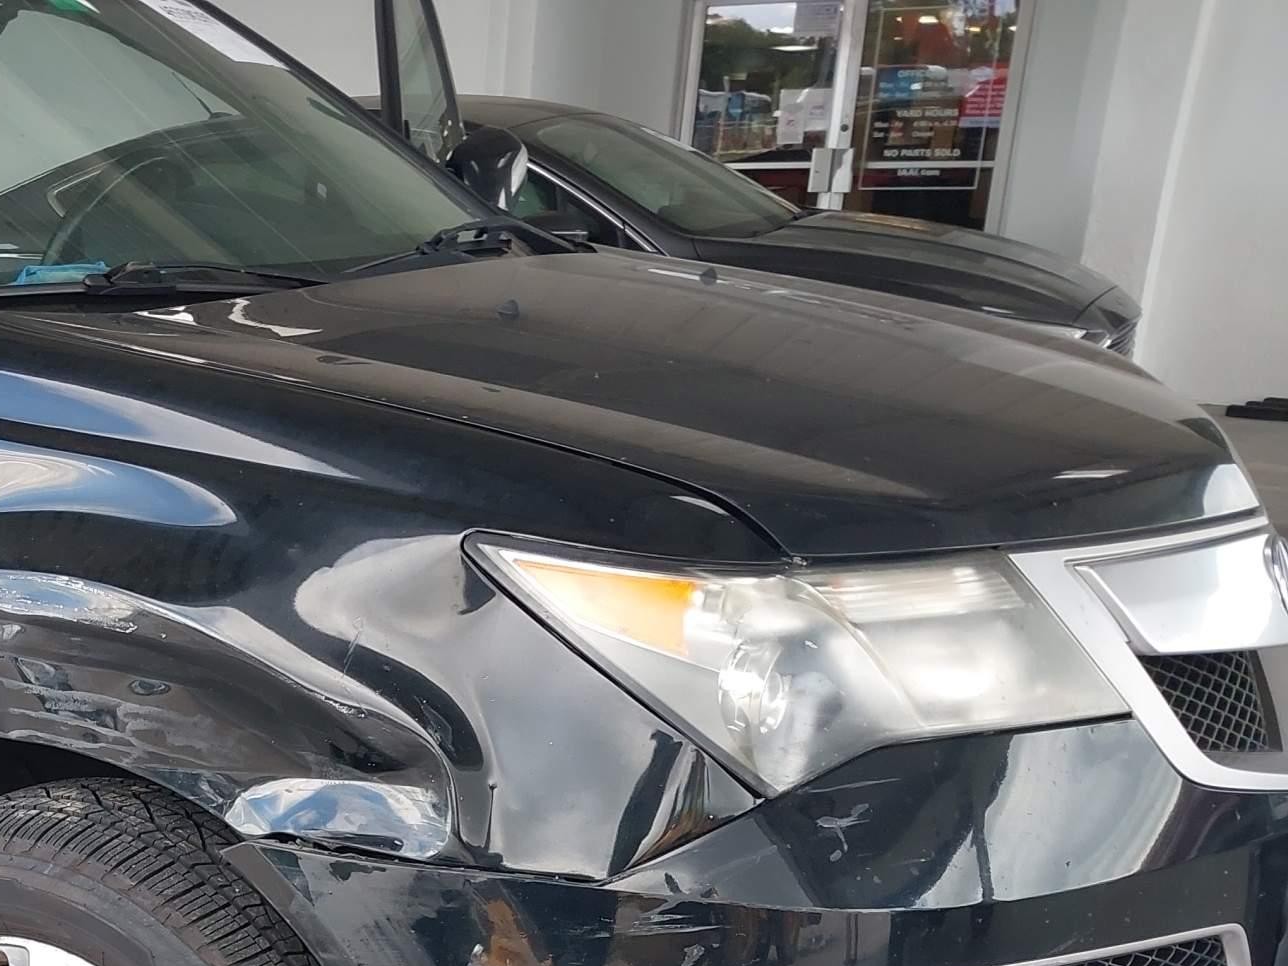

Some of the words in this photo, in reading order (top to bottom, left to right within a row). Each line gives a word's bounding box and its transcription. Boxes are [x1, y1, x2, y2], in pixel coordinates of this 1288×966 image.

[883, 149, 899, 157] NO
[900, 148, 932, 157] PARTS
[934, 148, 961, 157] SOLD
